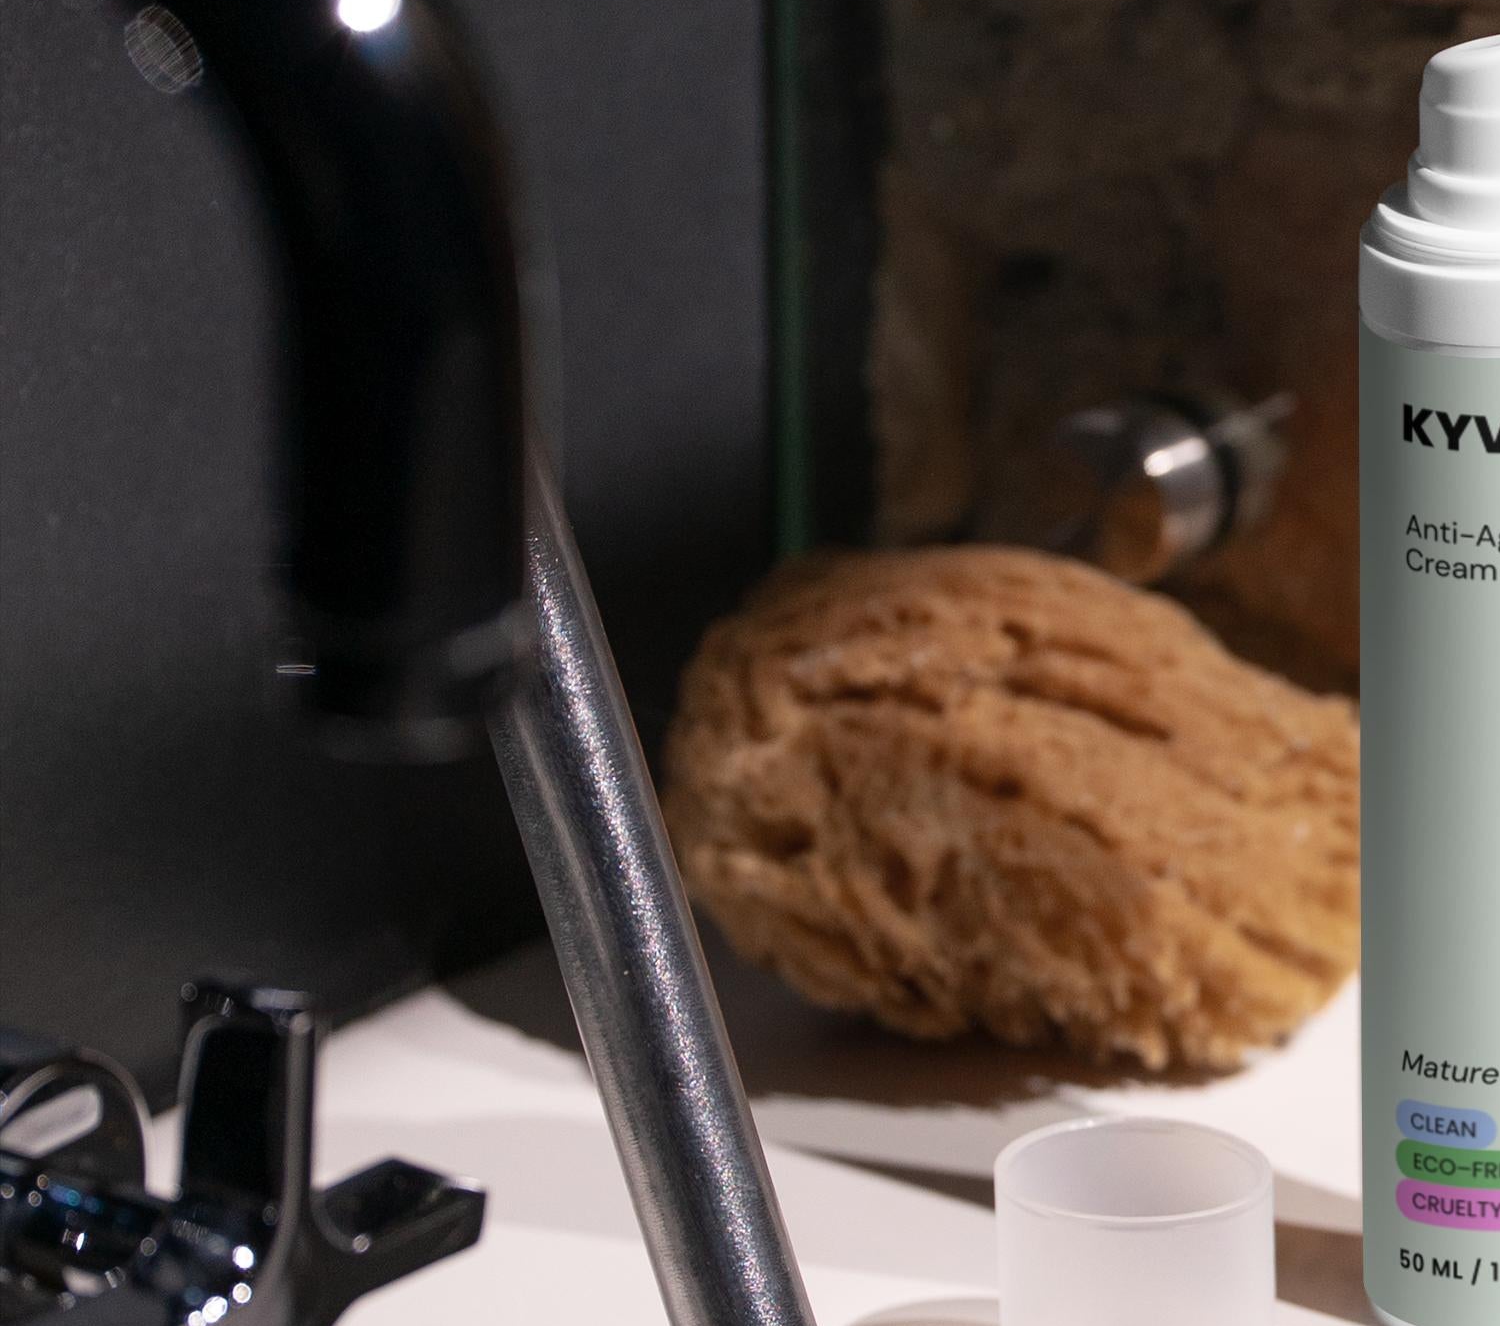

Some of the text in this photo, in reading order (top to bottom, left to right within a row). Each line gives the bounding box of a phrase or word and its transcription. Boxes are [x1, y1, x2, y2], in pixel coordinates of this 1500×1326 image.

[1405, 548, 1497, 581] Cream
[1401, 1049, 1500, 1086] Mature
[1410, 1112, 1477, 1138] CLEAN
[1399, 1248, 1425, 1273] 50
[1432, 1259, 1463, 1280] ML
[1471, 1258, 1482, 1285] /
